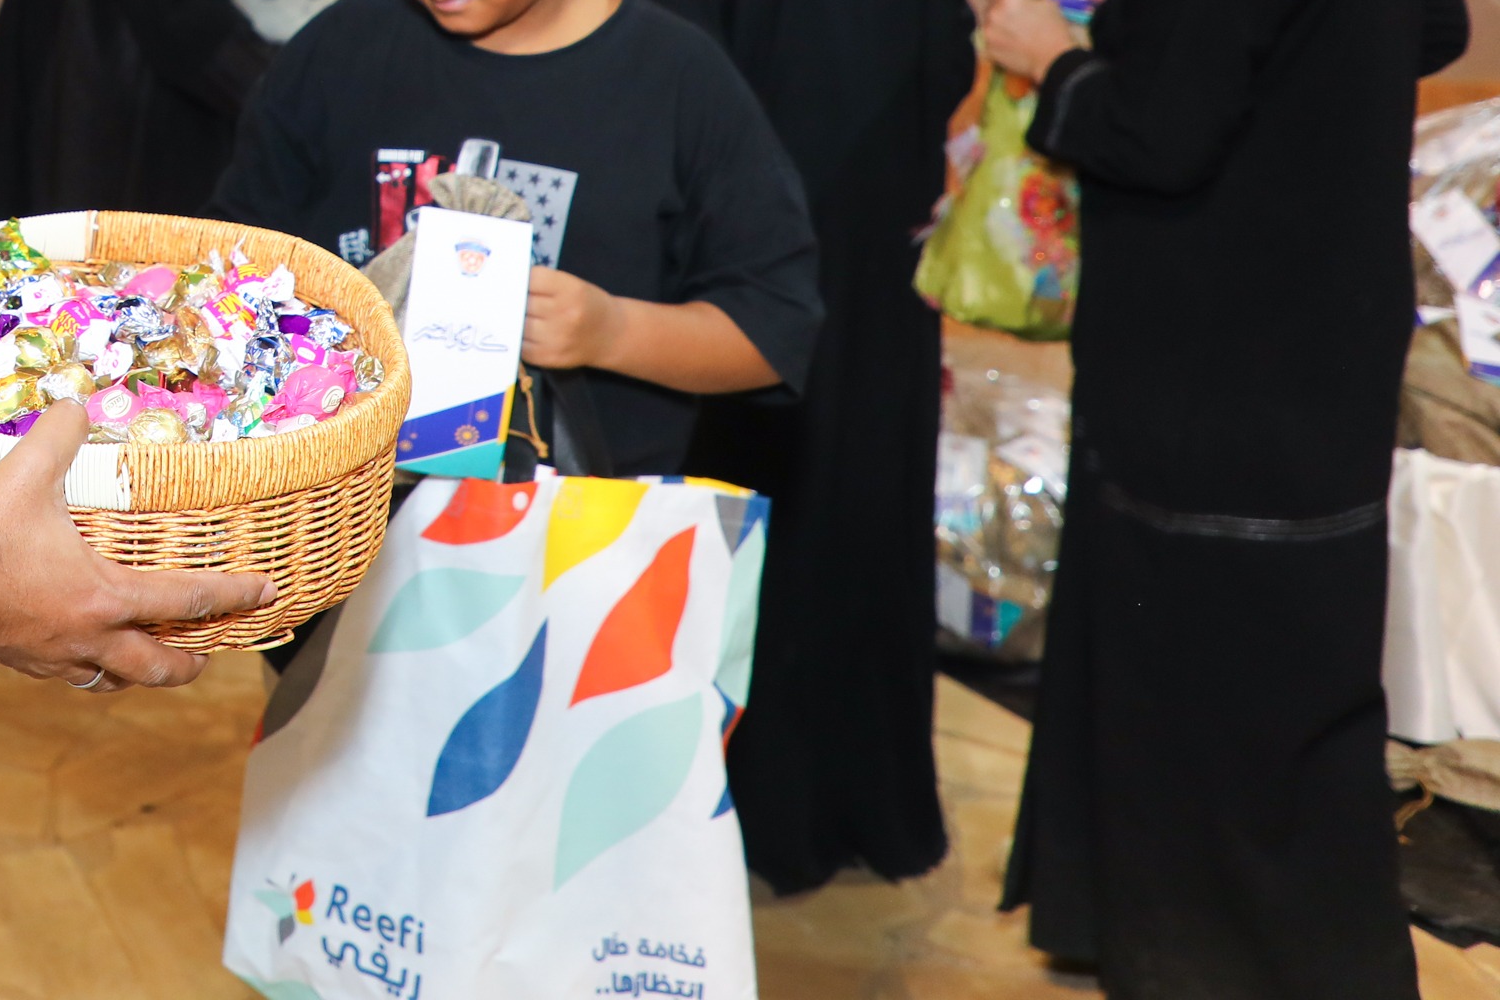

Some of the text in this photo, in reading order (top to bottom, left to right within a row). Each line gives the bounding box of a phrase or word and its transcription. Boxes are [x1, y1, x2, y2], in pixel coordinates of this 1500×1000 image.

[213, 292, 243, 316] ME
[326, 883, 424, 954] Reefi
[321, 936, 422, 1000] ريفي
[637, 938, 706, 968] فخامة
